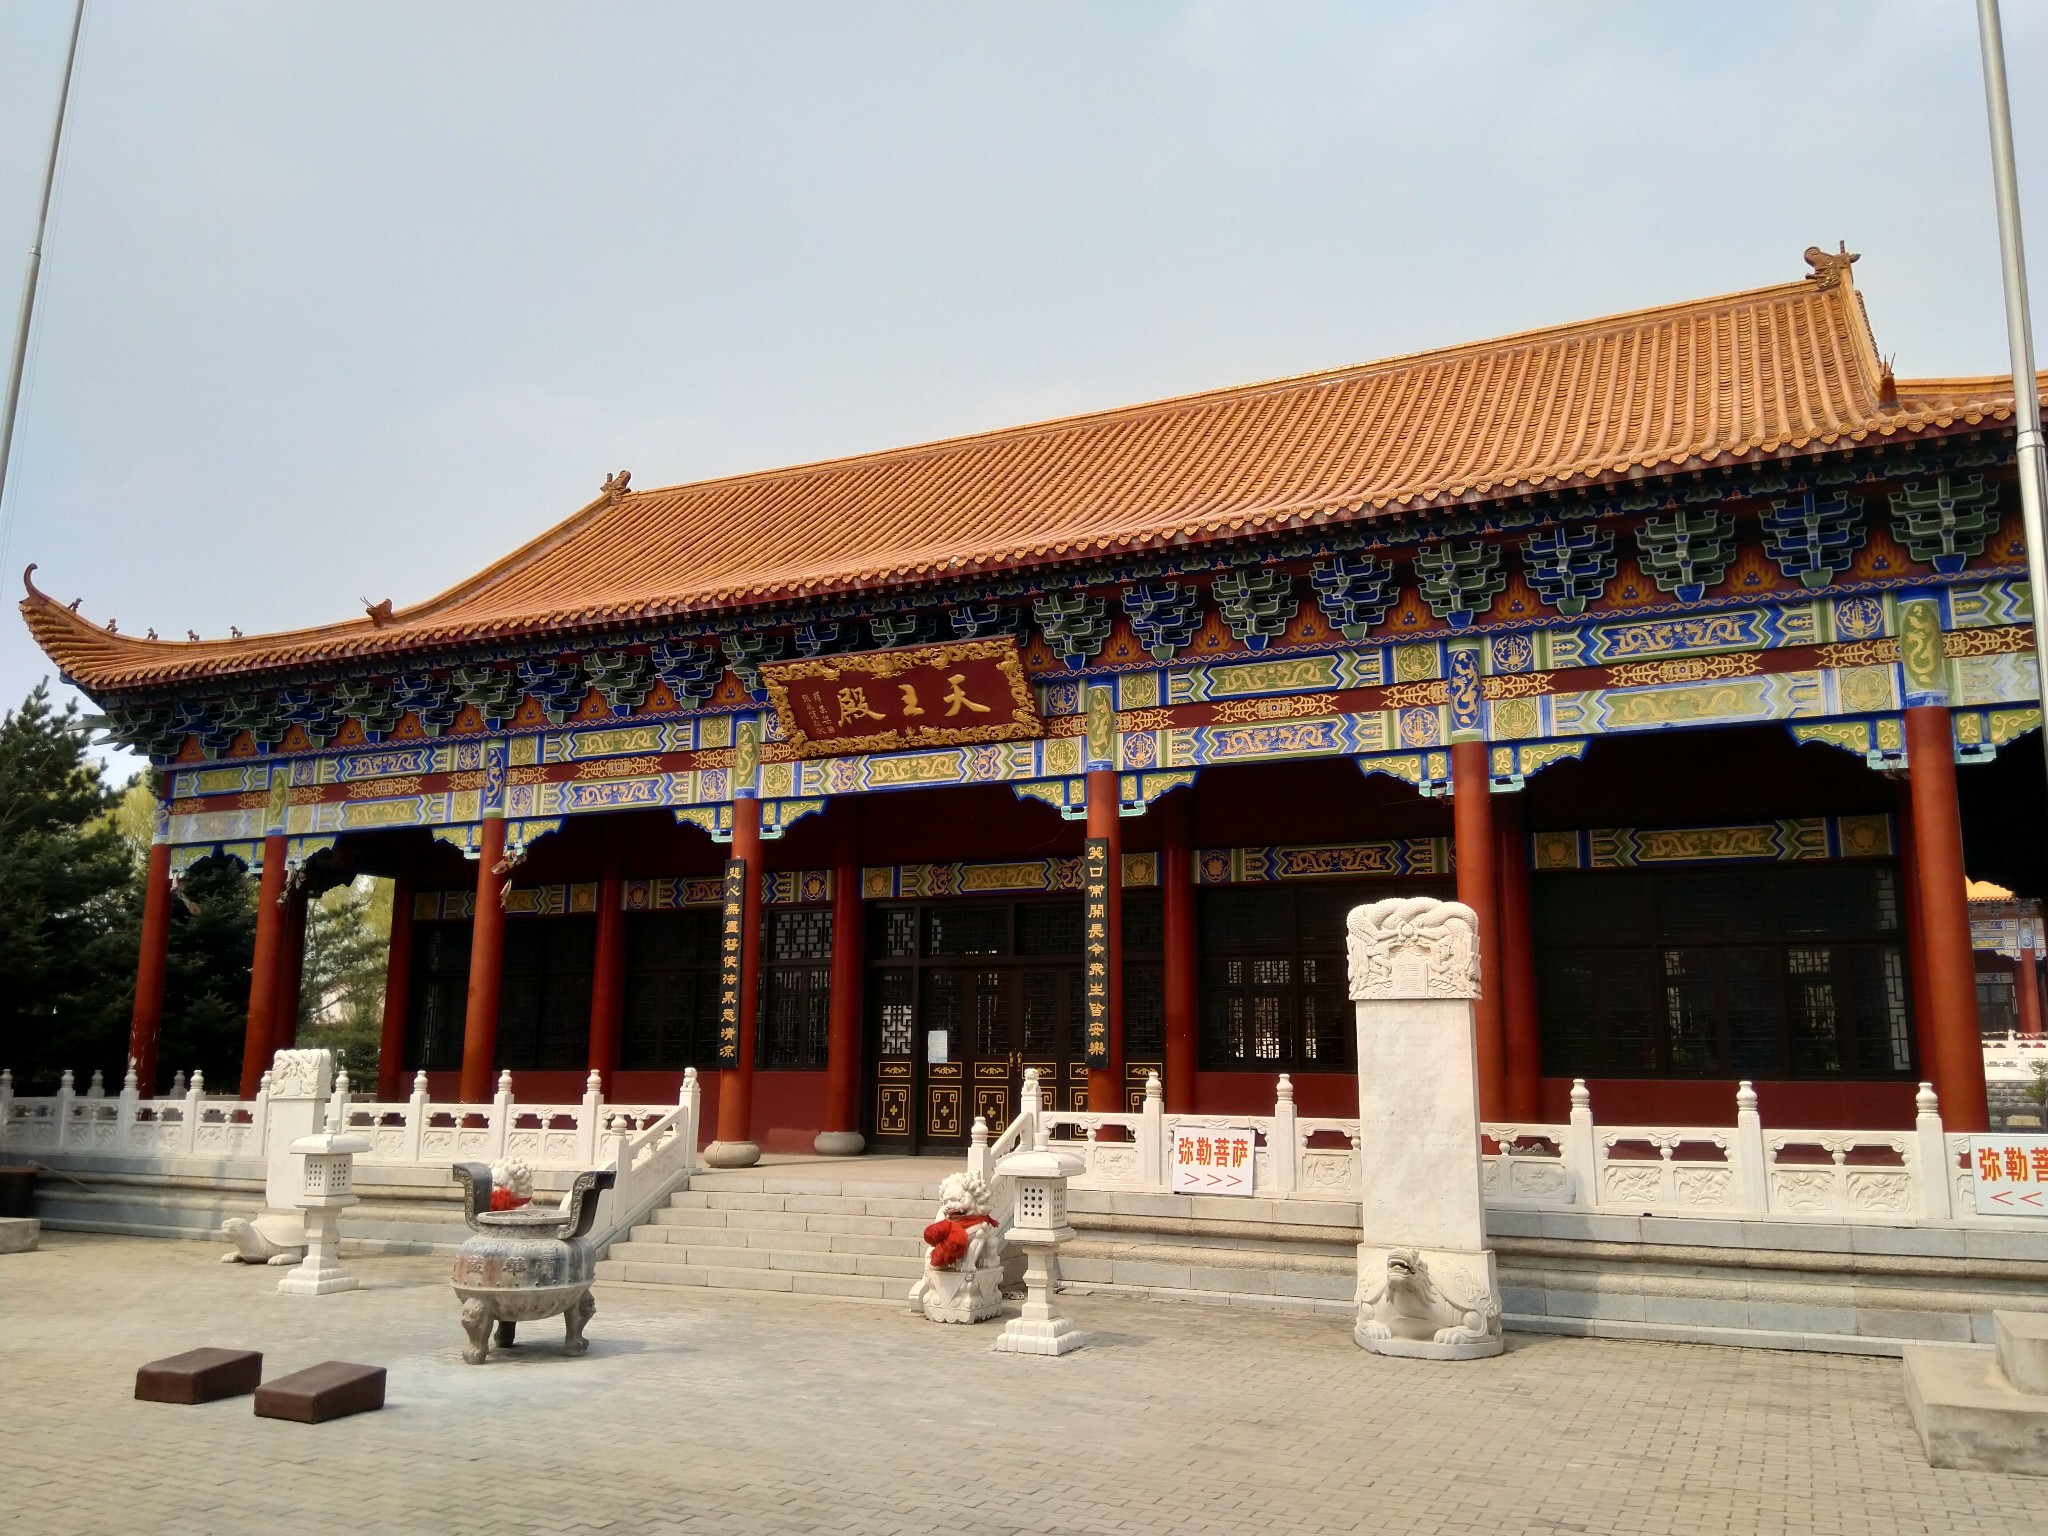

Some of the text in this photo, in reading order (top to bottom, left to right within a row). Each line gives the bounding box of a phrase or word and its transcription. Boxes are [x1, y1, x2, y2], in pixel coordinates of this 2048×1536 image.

[837, 673, 991, 728] 天王殿
[1178, 1136, 1249, 1168] 弥勒菩萨
